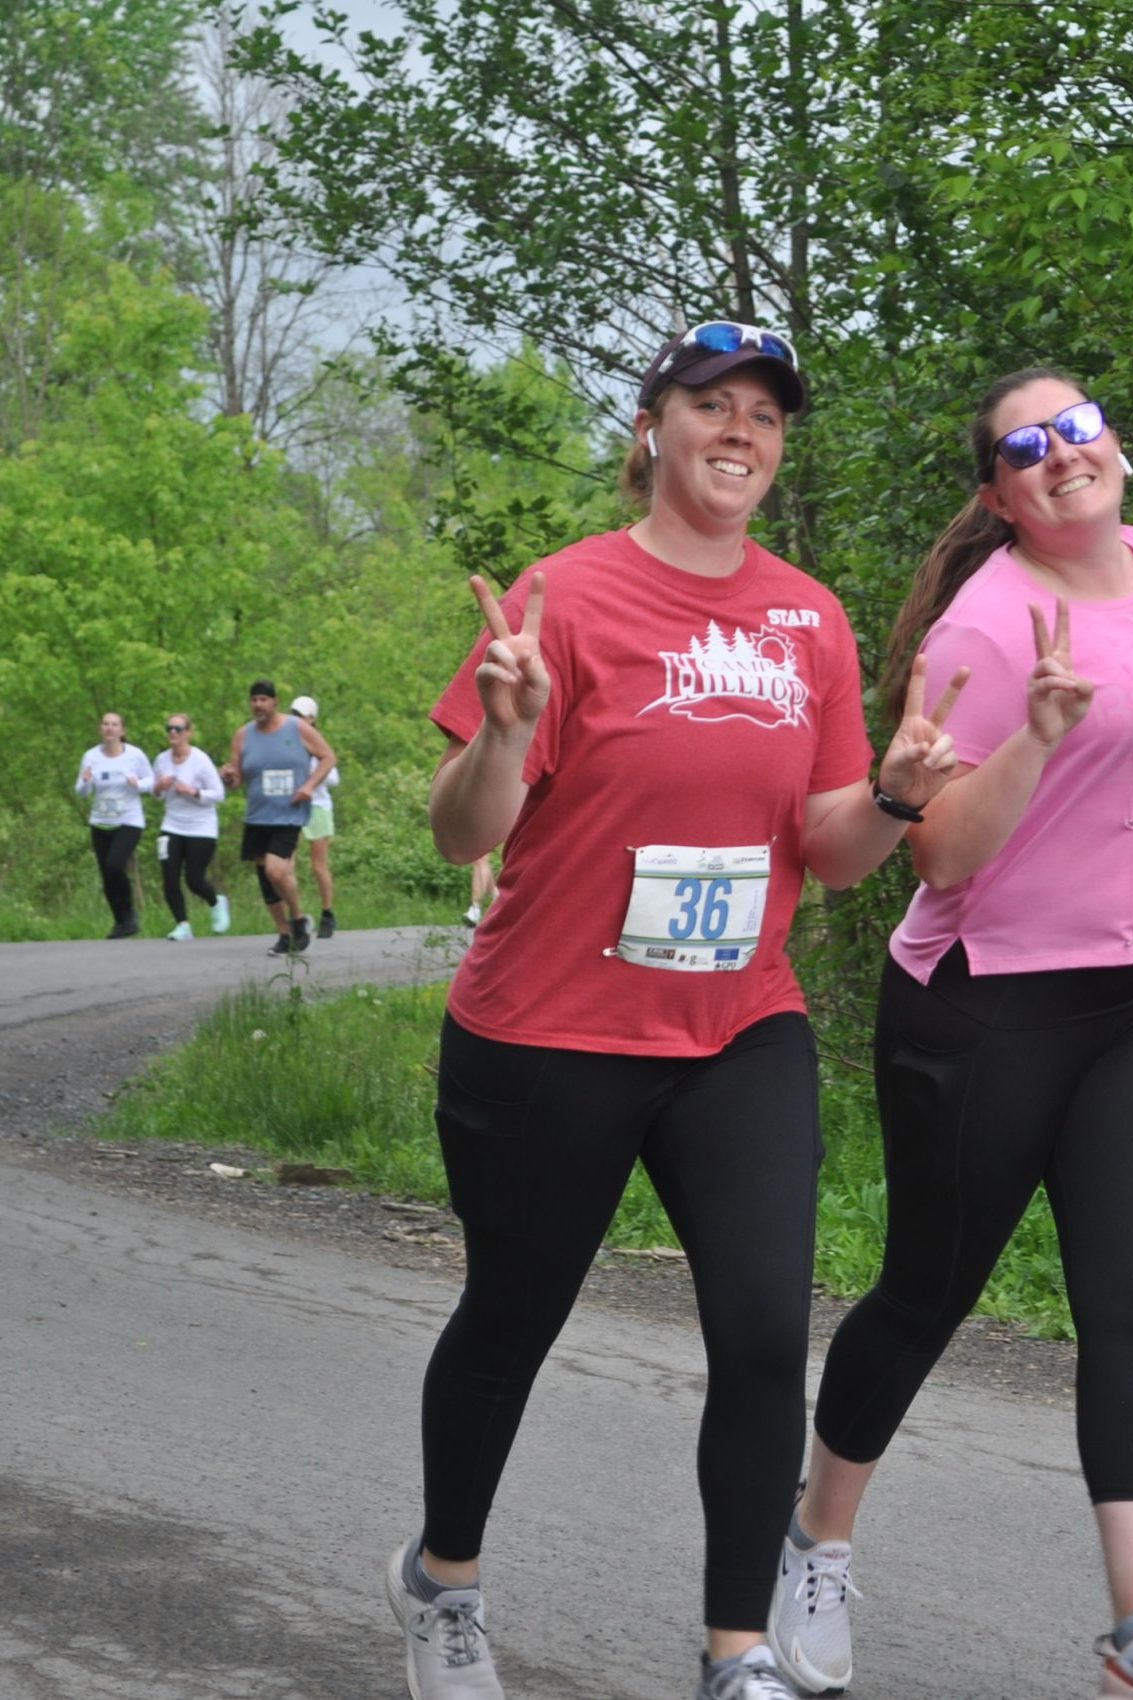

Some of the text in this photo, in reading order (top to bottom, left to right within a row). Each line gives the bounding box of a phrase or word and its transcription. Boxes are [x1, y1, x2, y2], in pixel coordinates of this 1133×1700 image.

[767, 608, 820, 627] STAFF
[702, 658, 773, 673] CAMP
[659, 651, 809, 726] HILLTOP
[668, 878, 732, 941] 36
